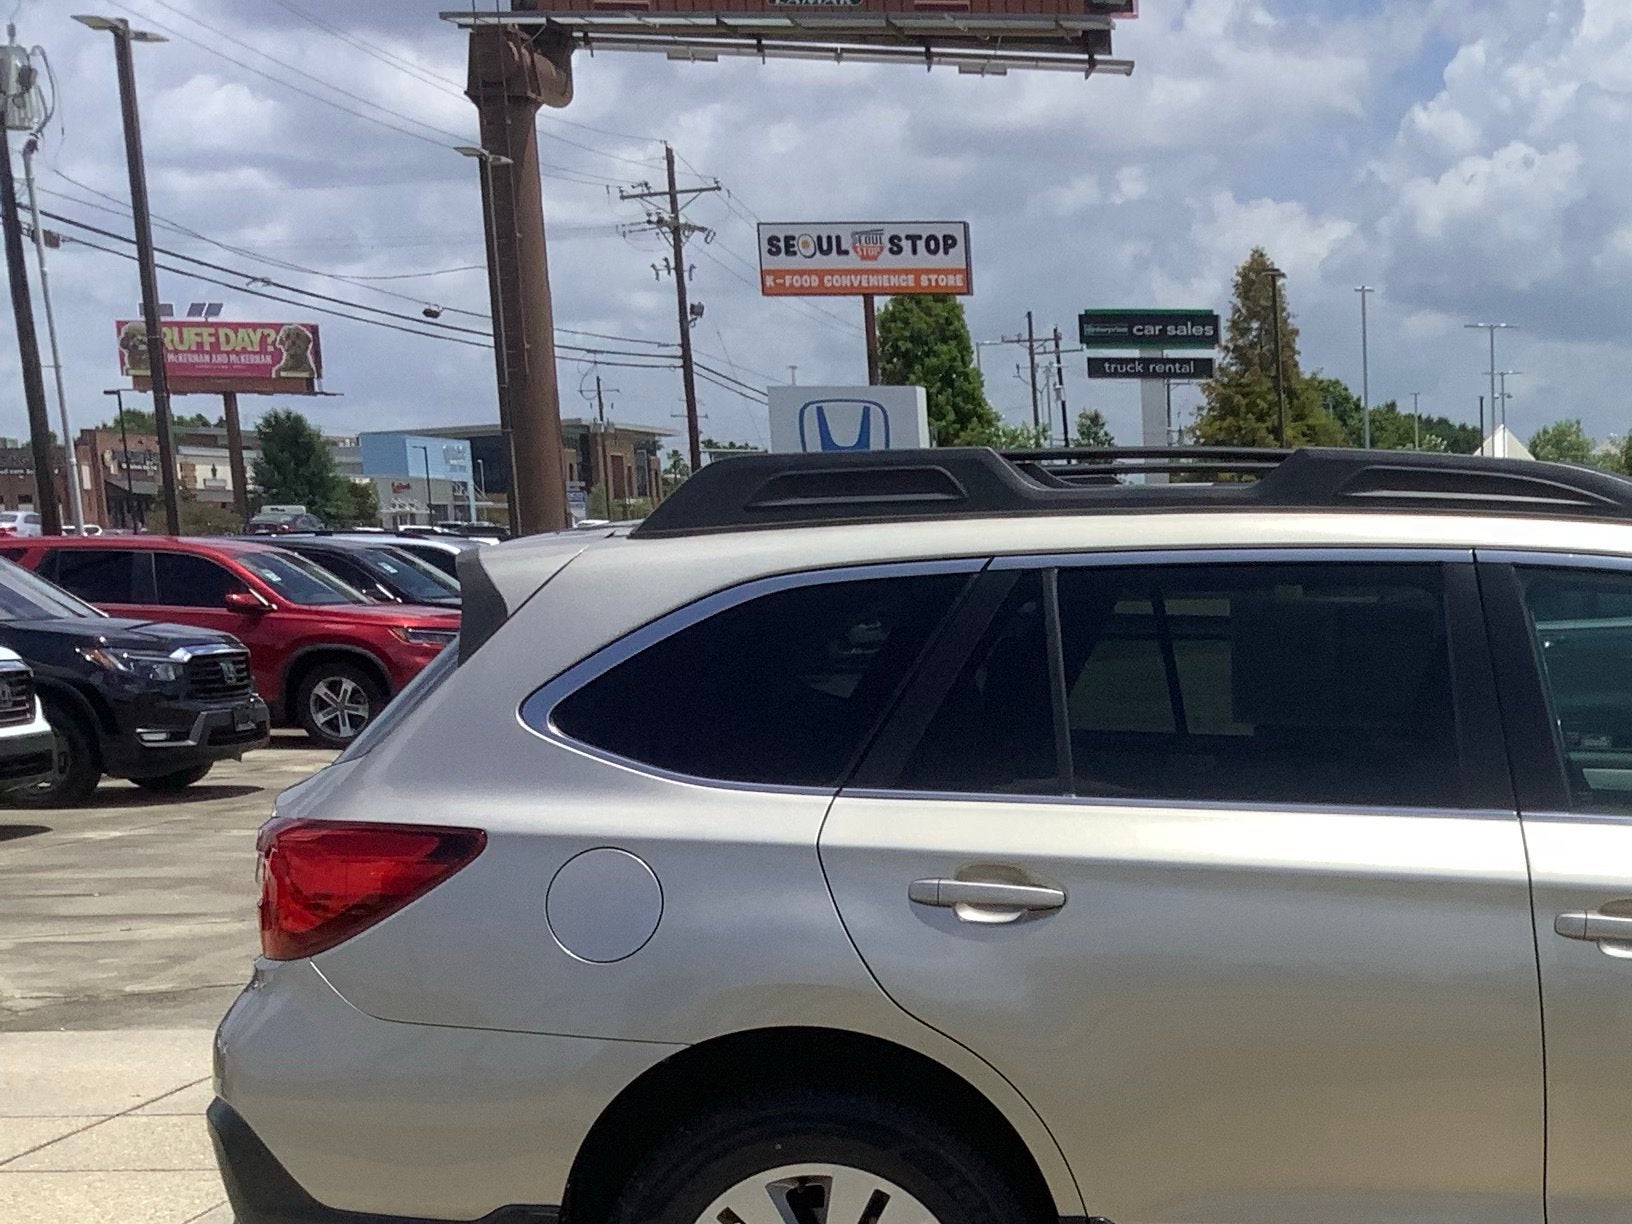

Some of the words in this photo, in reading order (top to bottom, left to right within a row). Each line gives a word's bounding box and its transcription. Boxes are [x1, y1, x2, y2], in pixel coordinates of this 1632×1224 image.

[767, 233, 849, 259] SEOUL
[888, 233, 958, 256] STOP
[765, 274, 820, 288] K-FOOD
[823, 274, 915, 288] CONVENIENCE
[920, 273, 964, 287] STORE
[1132, 323, 1163, 336] car
[1166, 321, 1214, 336] sales
[162, 325, 216, 351] RUFF
[218, 327, 277, 352] DAY?
[212, 353, 229, 364] AND
[1104, 360, 1144, 373] truck
[1149, 360, 1194, 374] rental
